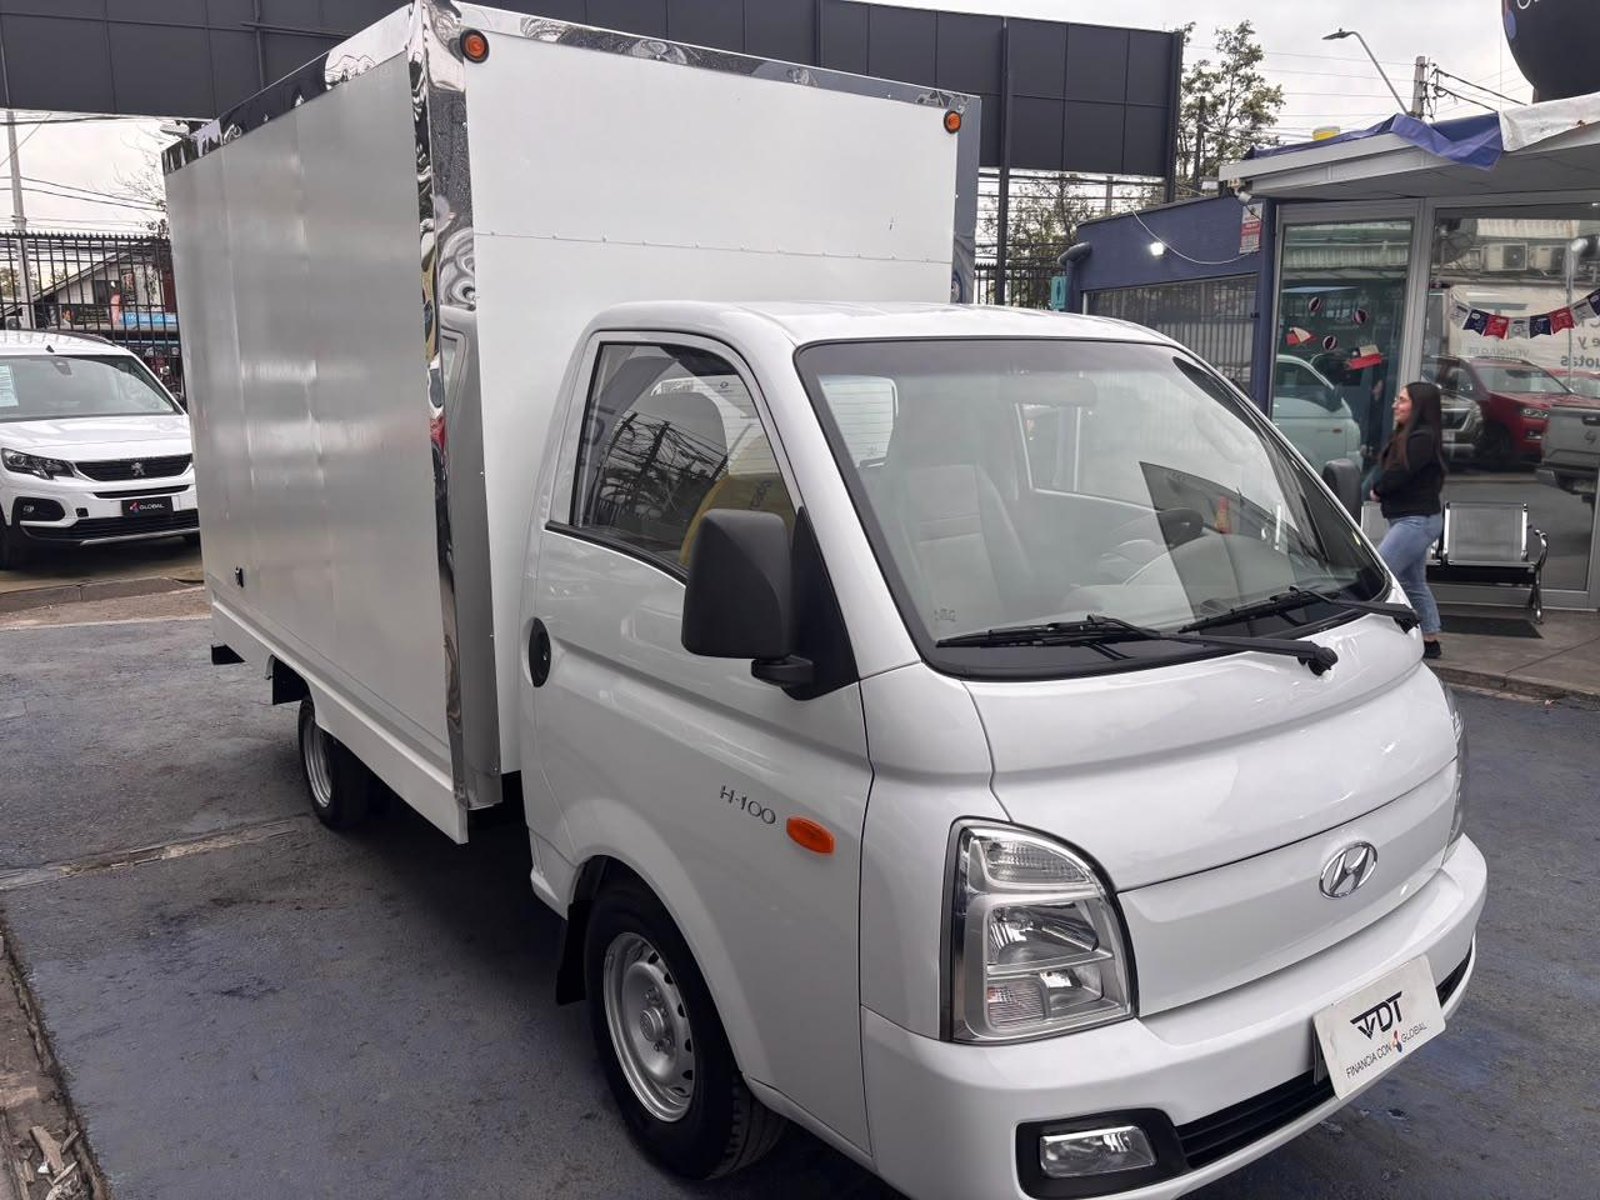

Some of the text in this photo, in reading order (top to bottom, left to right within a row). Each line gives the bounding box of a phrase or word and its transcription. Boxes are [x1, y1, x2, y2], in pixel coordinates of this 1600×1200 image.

[720, 785, 776, 825] H-100
[1350, 991, 1402, 1040] VDT
[1345, 1023, 1428, 1079] FINANCIA CON GLOBAL
